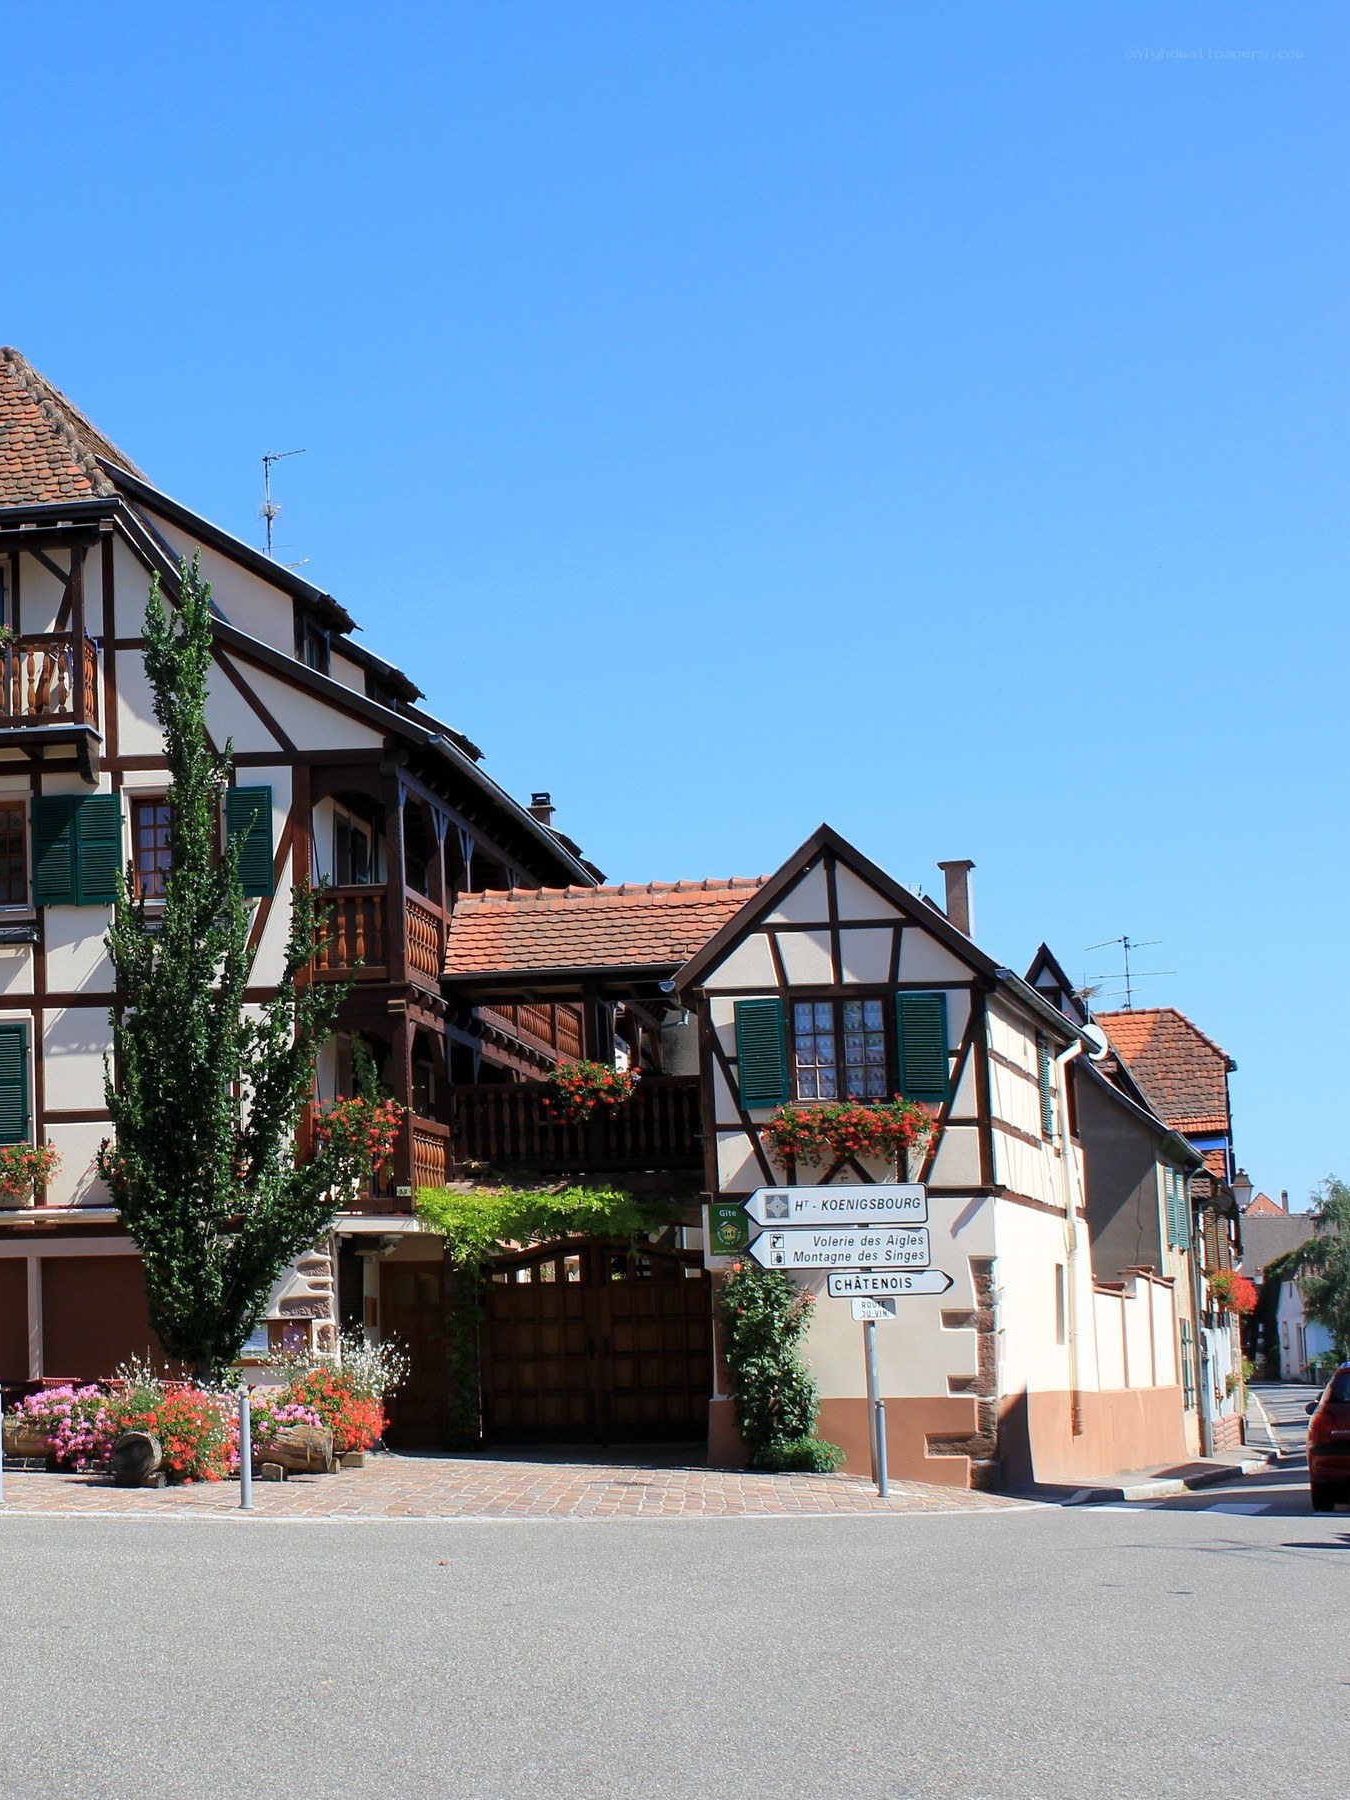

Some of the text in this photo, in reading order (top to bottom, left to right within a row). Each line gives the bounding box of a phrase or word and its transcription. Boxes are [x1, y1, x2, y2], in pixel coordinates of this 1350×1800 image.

[821, 1197, 921, 1211] KOENIGSBOURG
[813, 1234, 924, 1249] Volerie des Aigles
[792, 1249, 925, 1265] Montagne des Singes
[834, 1275, 913, 1291] CHÂTENOIS
[861, 1300, 886, 1309] ROUTE
[874, 1309, 888, 1318] VIN
